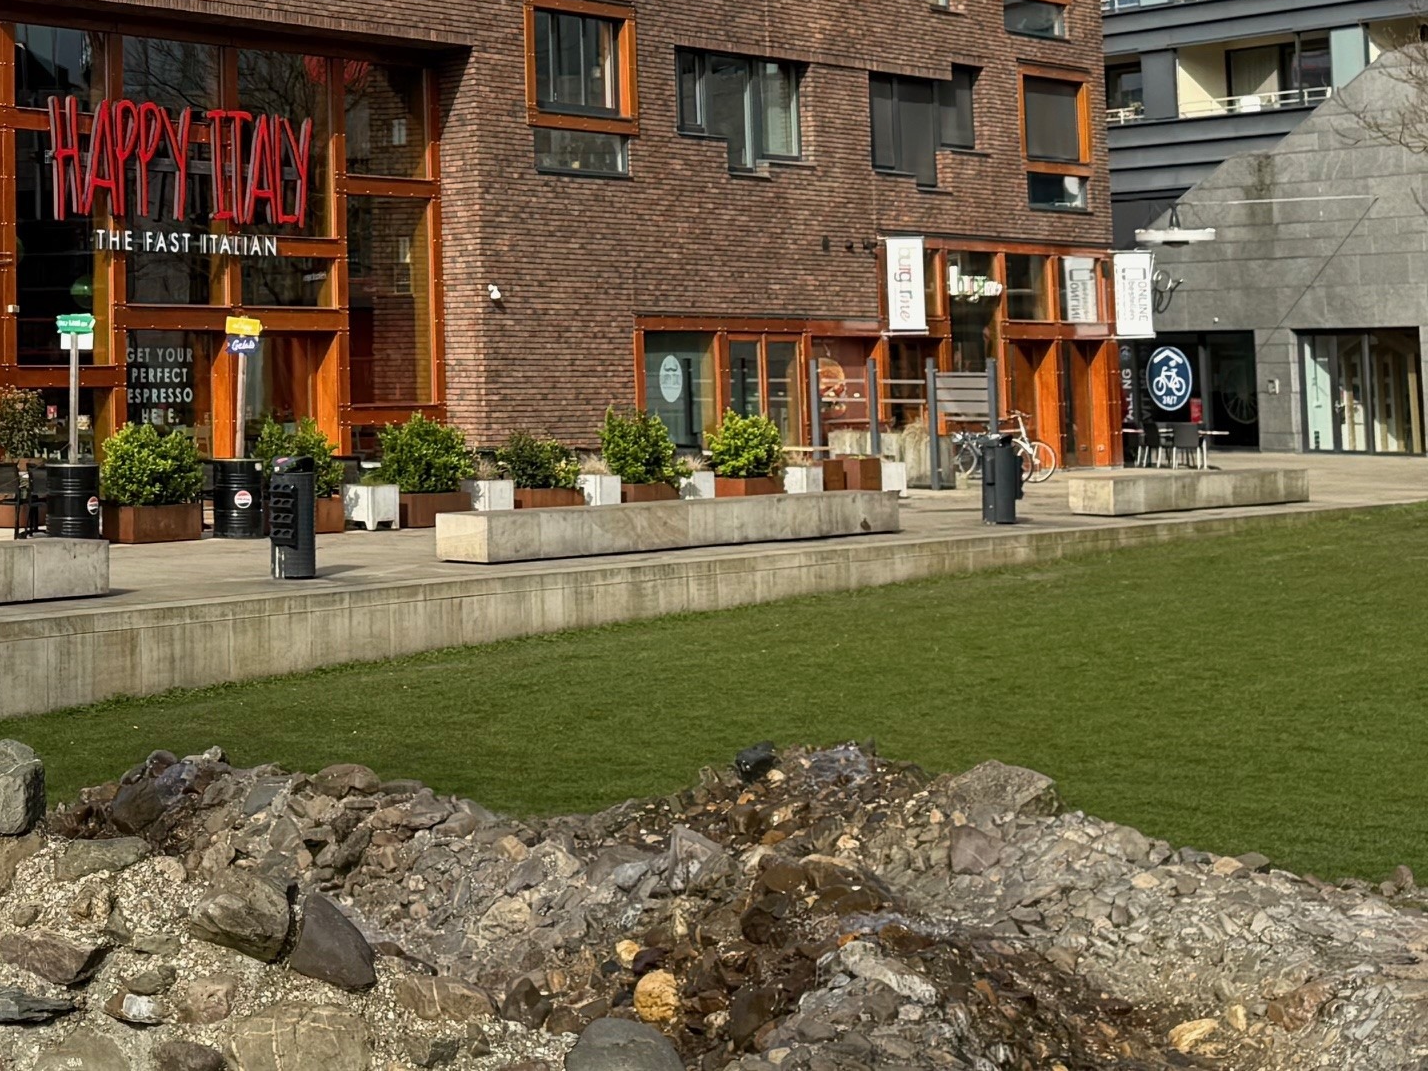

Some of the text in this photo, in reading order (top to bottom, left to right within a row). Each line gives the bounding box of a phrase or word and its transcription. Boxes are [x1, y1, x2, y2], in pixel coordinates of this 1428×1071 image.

[48, 95, 313, 228] HAPPY ITALY
[95, 229, 278, 256] THE FAST ITALIAN
[1138, 281, 1149, 322] ONLINE
[126, 347, 193, 363] GET YOUR
[131, 367, 188, 383] PERFECT
[127, 387, 193, 404] ESPRESSO
